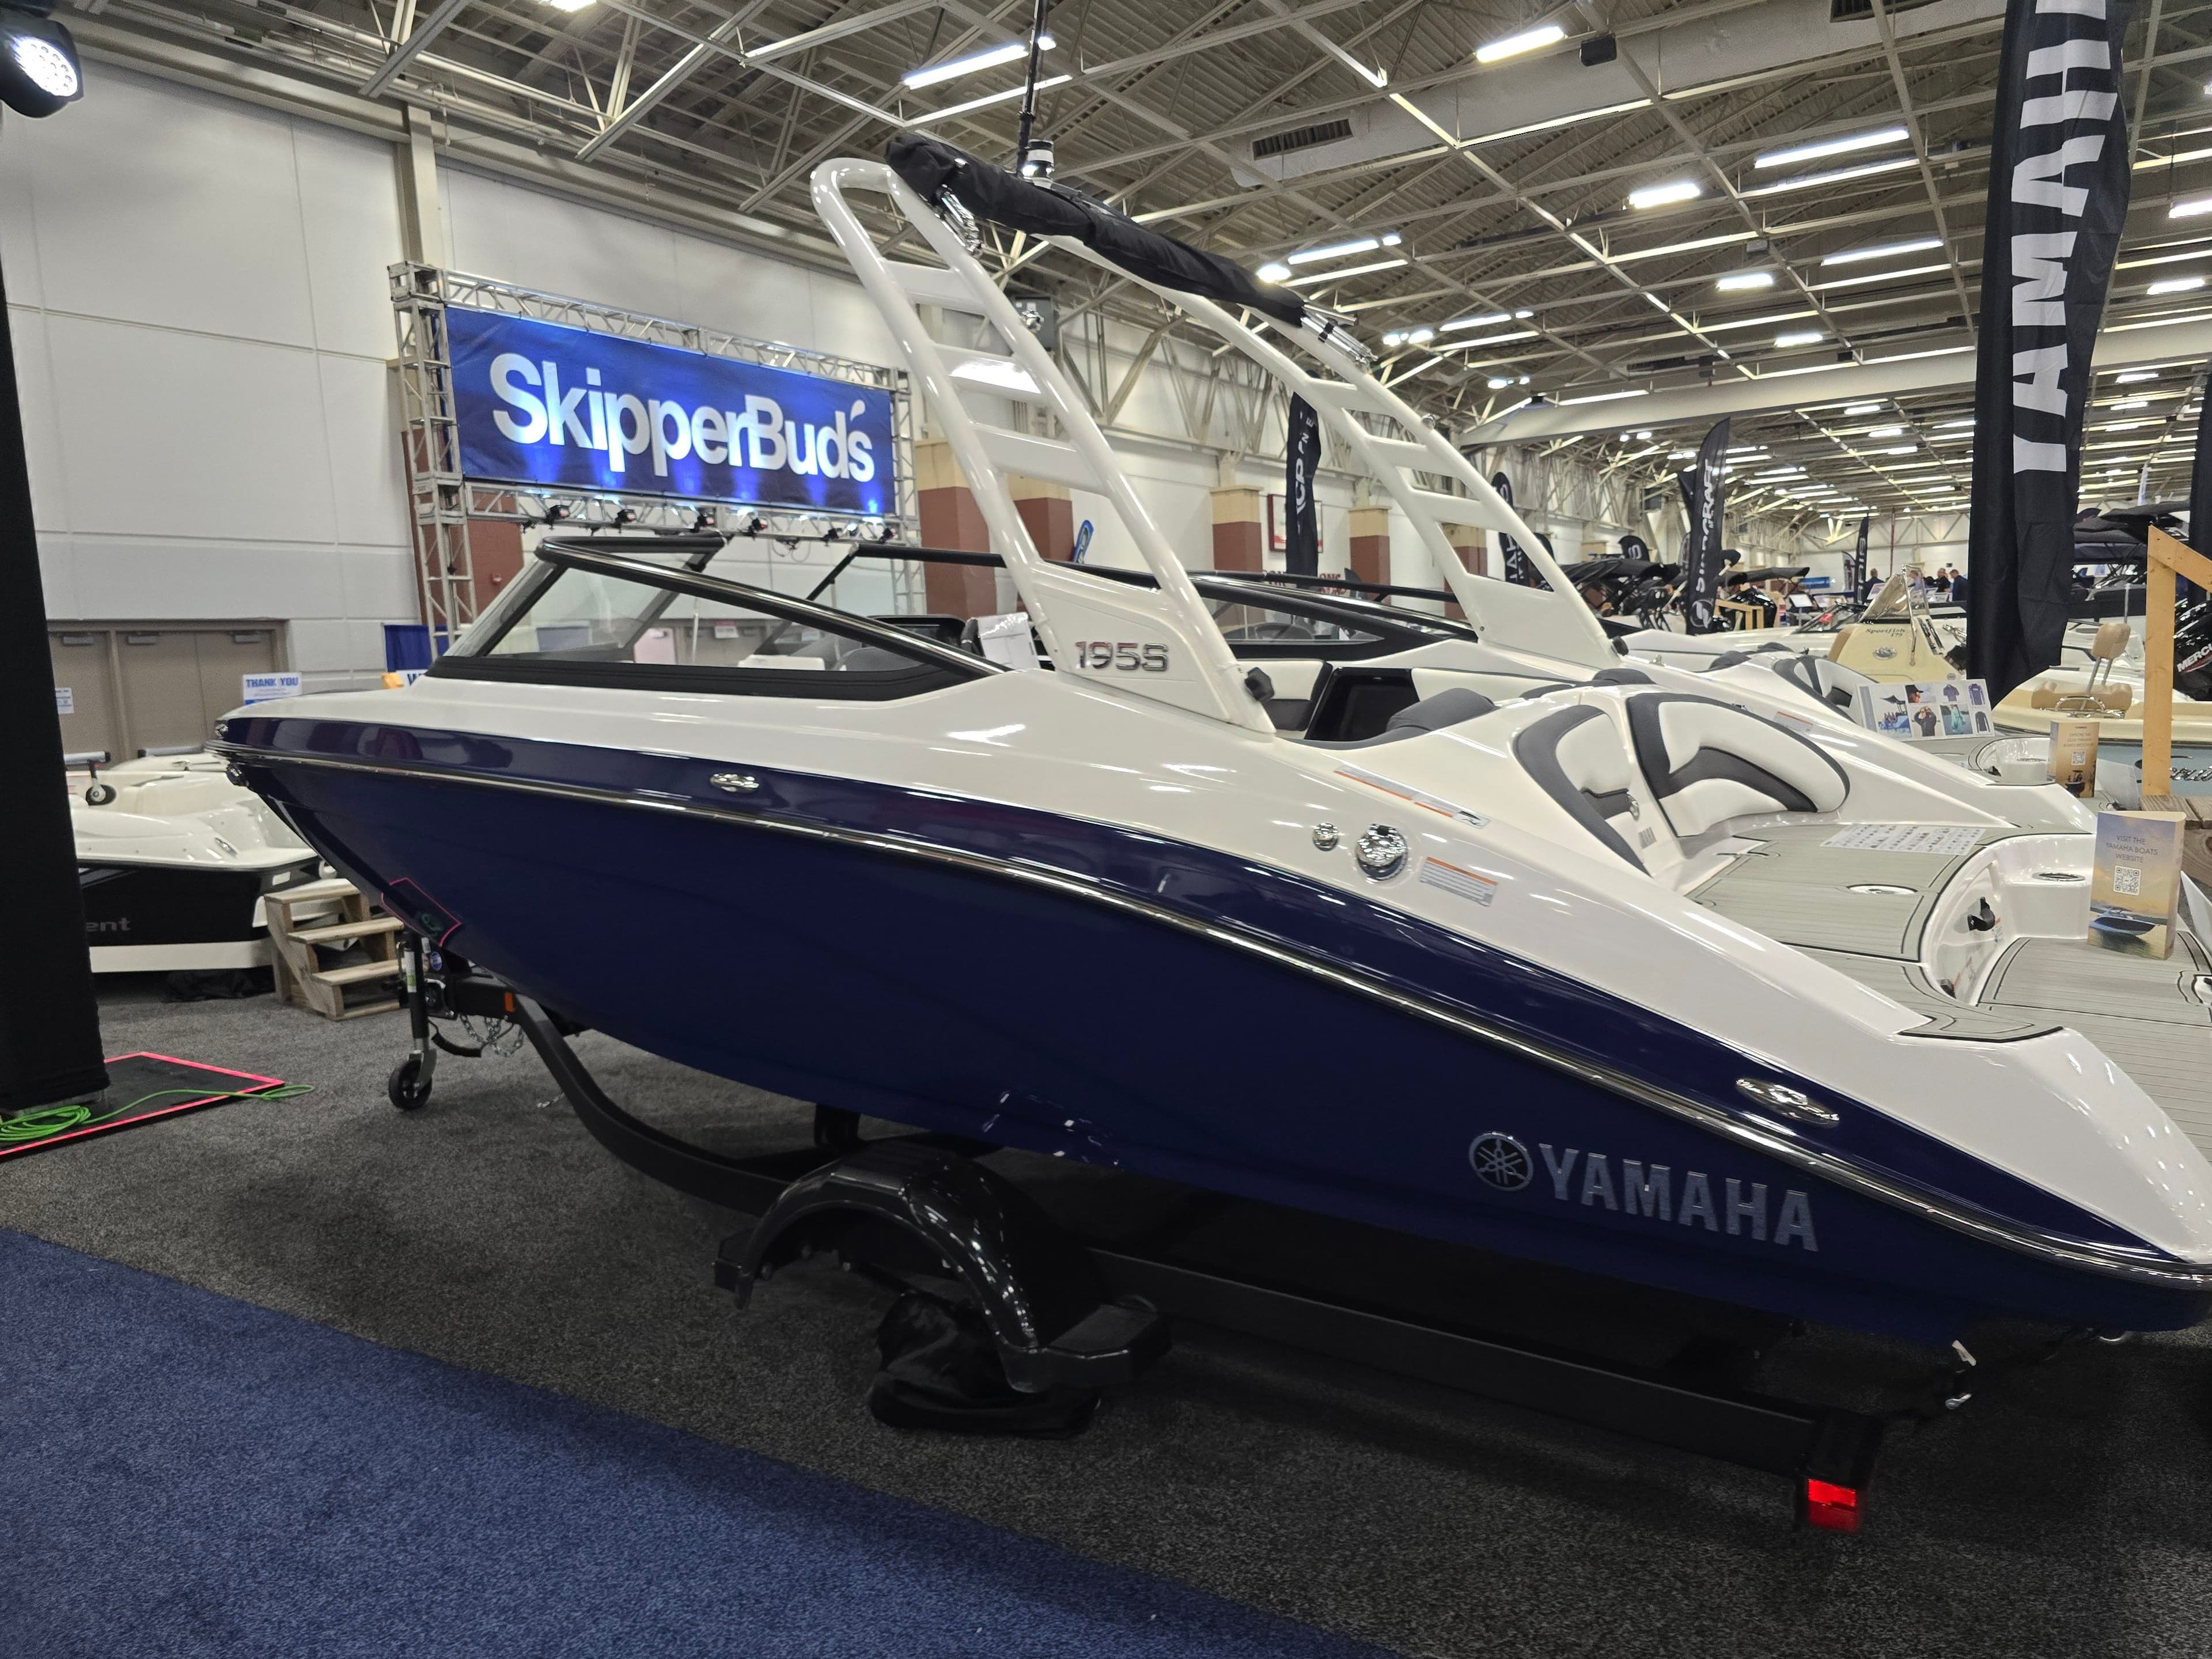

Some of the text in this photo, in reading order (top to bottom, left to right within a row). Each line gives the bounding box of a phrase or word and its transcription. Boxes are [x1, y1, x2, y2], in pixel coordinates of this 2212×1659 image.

[2011, 0, 2118, 474] YAMAH
[1075, 641, 1169, 673] 195S
[246, 677, 298, 688] THANK YOU
[2133, 837, 2147, 845] THE
[2105, 842, 2158, 855] YAMAHA BOATS
[2115, 853, 2144, 863] WEBSITE
[1539, 1143, 1819, 1252] YAMAHA
